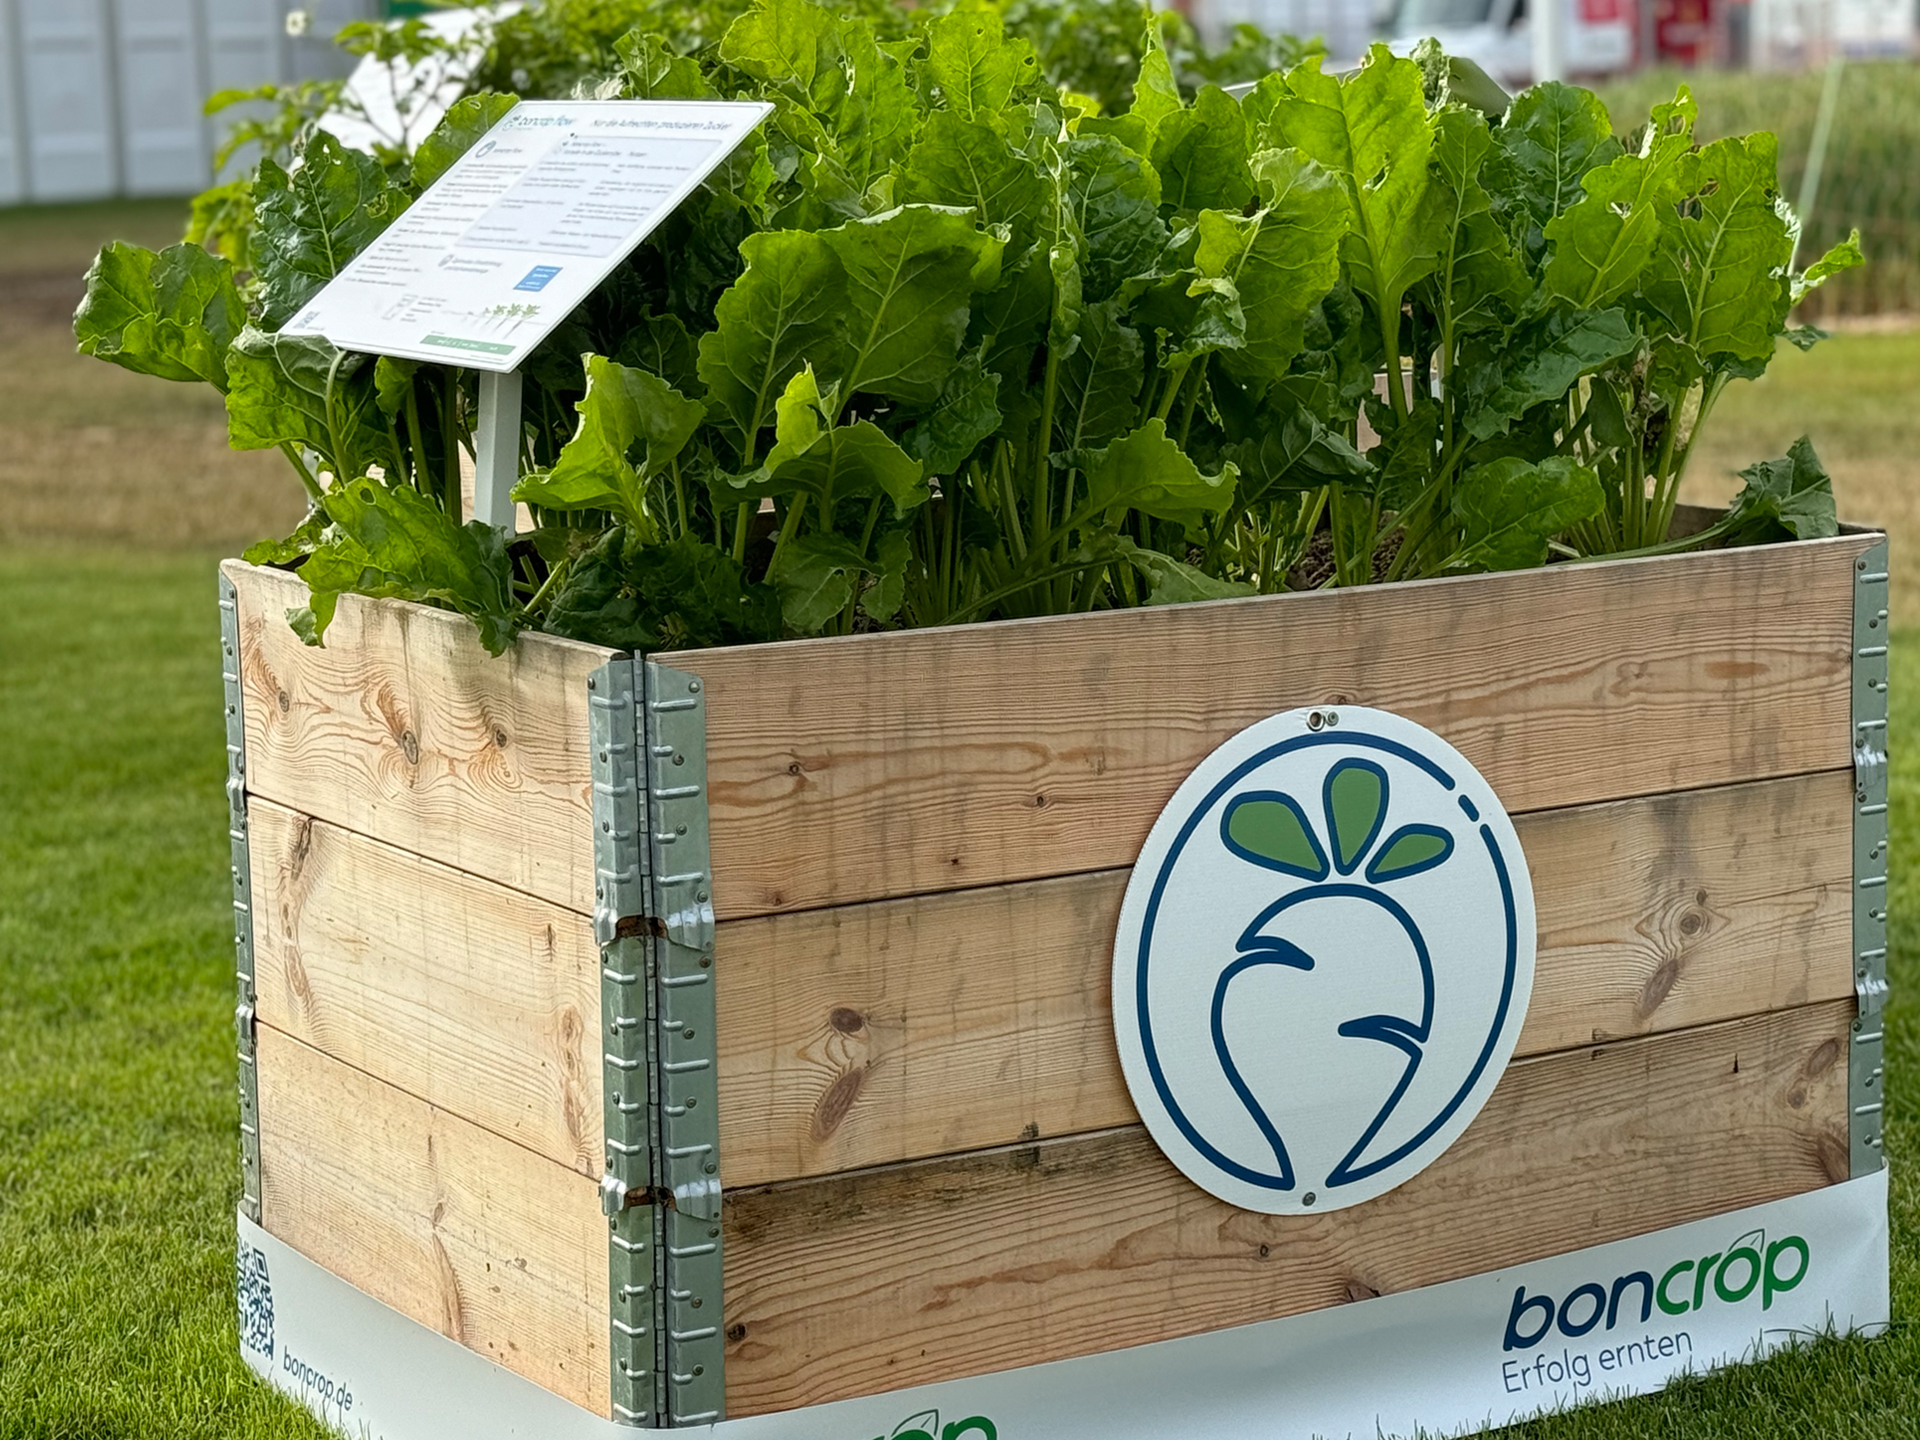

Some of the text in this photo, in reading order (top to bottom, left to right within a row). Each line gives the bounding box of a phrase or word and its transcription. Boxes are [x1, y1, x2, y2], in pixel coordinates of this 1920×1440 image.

[1502, 1234, 1811, 1352] boncrop
[283, 1344, 354, 1412] boncrop.de
[1501, 1331, 1693, 1394] Erfolg ernten
